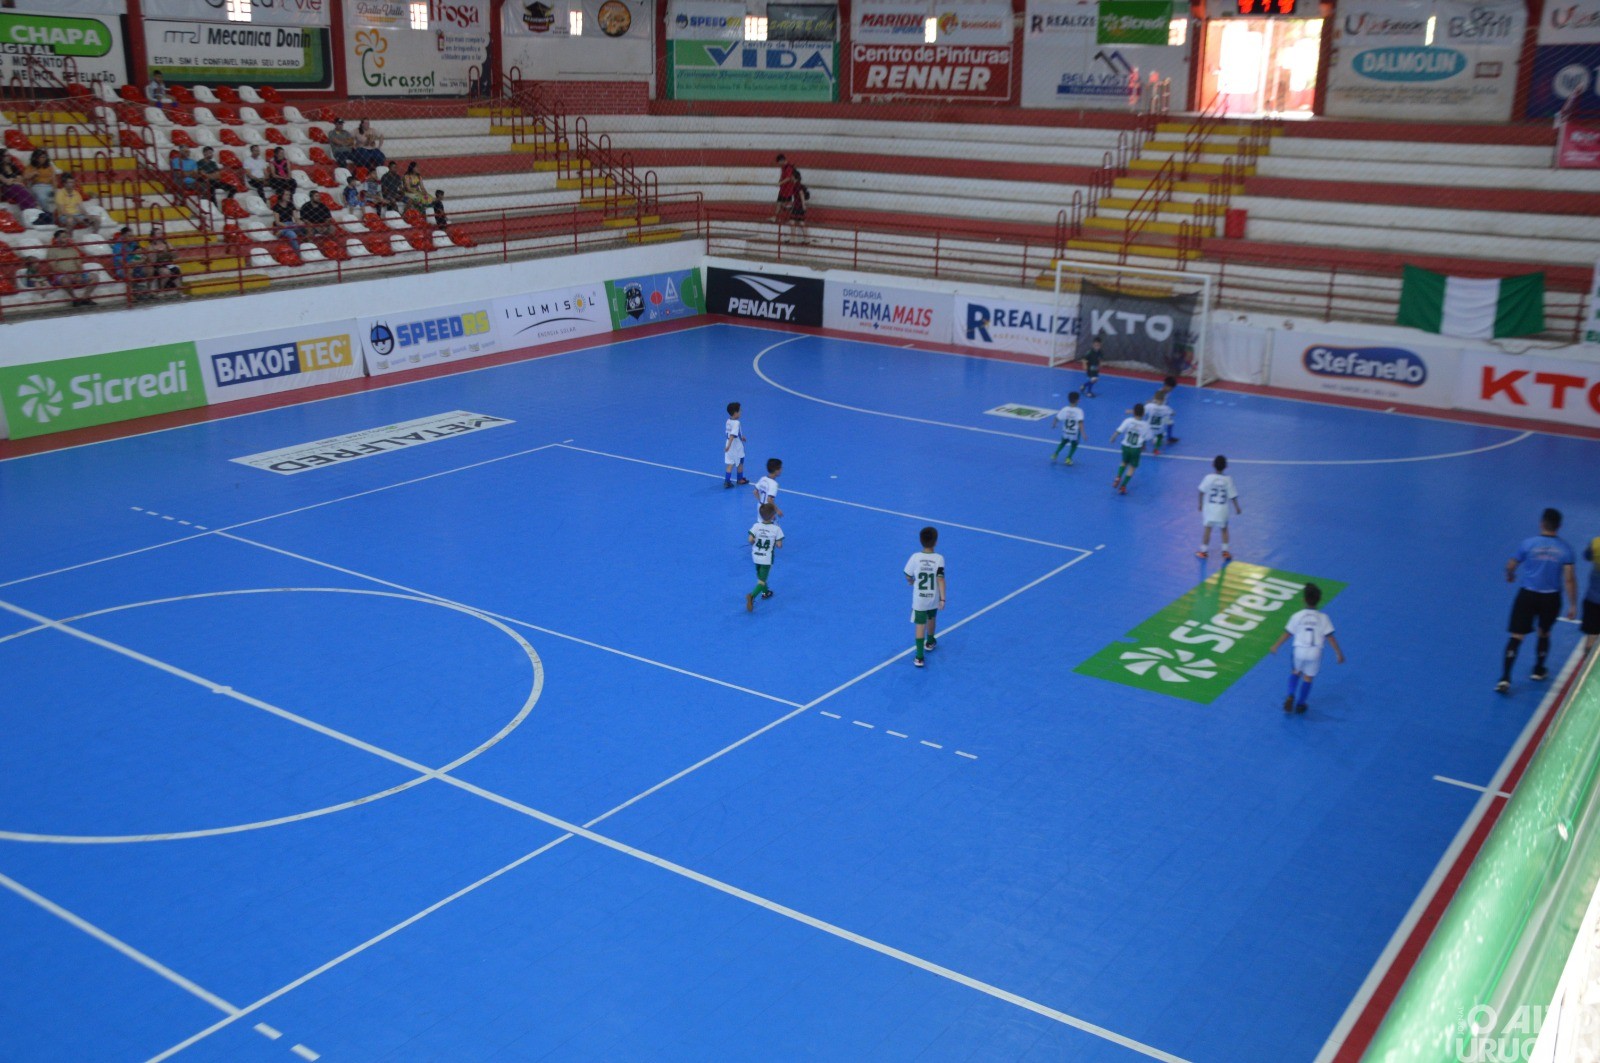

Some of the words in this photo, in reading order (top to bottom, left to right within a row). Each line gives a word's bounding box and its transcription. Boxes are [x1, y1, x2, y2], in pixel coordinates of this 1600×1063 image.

[861, 13, 925, 27] MARION
[1046, 15, 1097, 28] REALIZE
[10, 25, 102, 46] CHAPA
[706, 41, 835, 80] VIDA
[854, 46, 913, 63] Centro
[914, 46, 934, 63] de
[935, 47, 1010, 64] Pinturas
[1361, 52, 1458, 74] DALMOLIN
[361, 48, 436, 88] Girassol
[865, 65, 991, 91] RENNER
[842, 288, 882, 300] DROGARIA
[728, 297, 796, 321] PENALTY
[993, 308, 1082, 336] REALIZE
[1090, 309, 1174, 343] KTO
[1308, 347, 1425, 383] Stefanello
[70, 359, 188, 411] Sicredi
[1209, 488, 1228, 505] 23
[755, 538, 771, 552] 44
[918, 572, 935, 591] 21
[1169, 571, 1306, 654] Sicredi
[1305, 627, 1316, 647] 7
